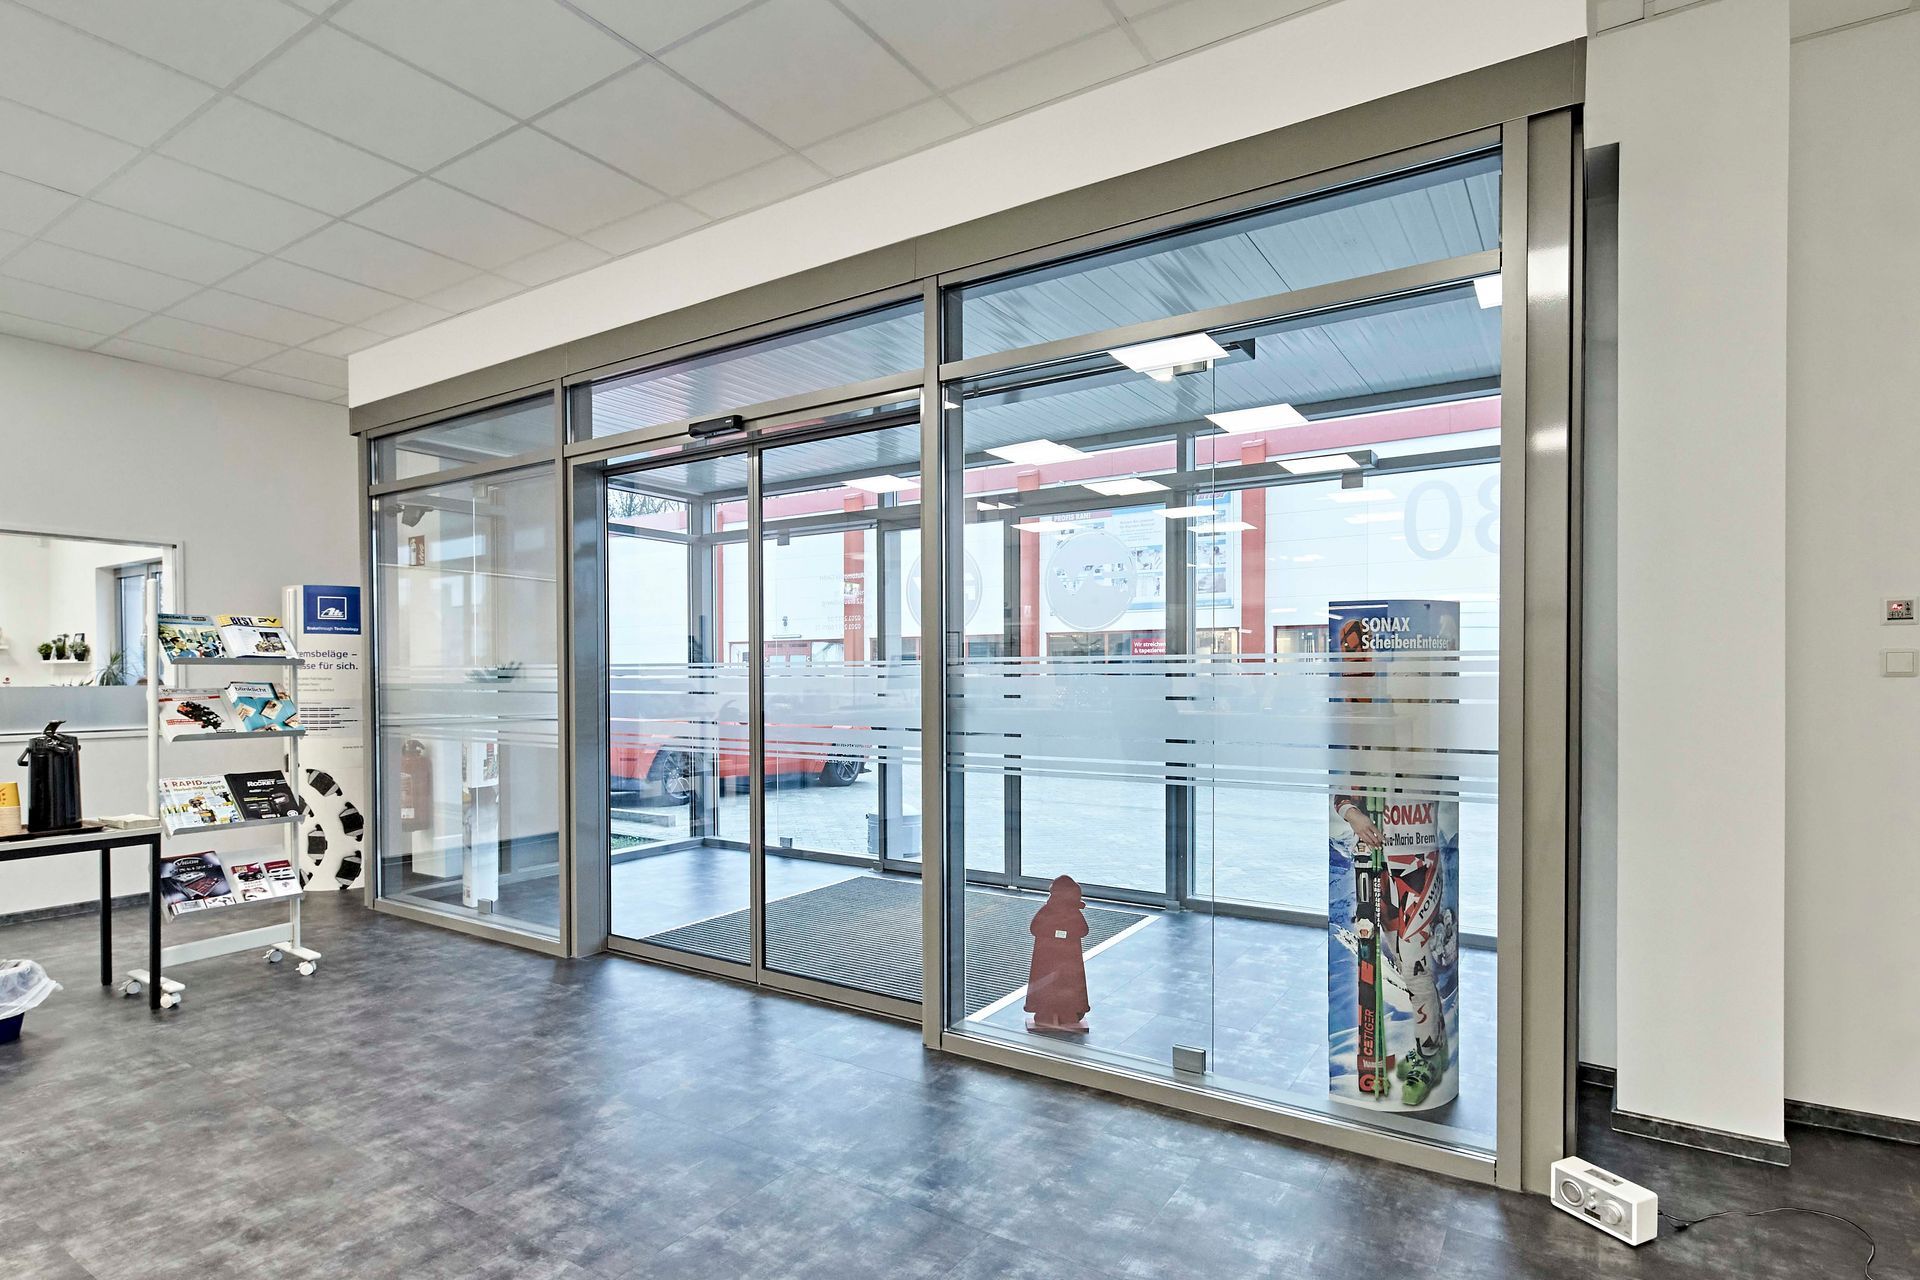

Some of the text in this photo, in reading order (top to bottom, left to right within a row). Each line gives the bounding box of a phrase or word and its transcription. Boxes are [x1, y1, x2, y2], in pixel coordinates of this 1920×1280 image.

[230, 616, 253, 625] BEST
[1361, 617, 1410, 632] SONAX
[319, 661, 333, 670] für
[336, 662, 359, 670] sich.
[1383, 803, 1433, 825] SONAX
[1415, 832, 1435, 844] Brem
